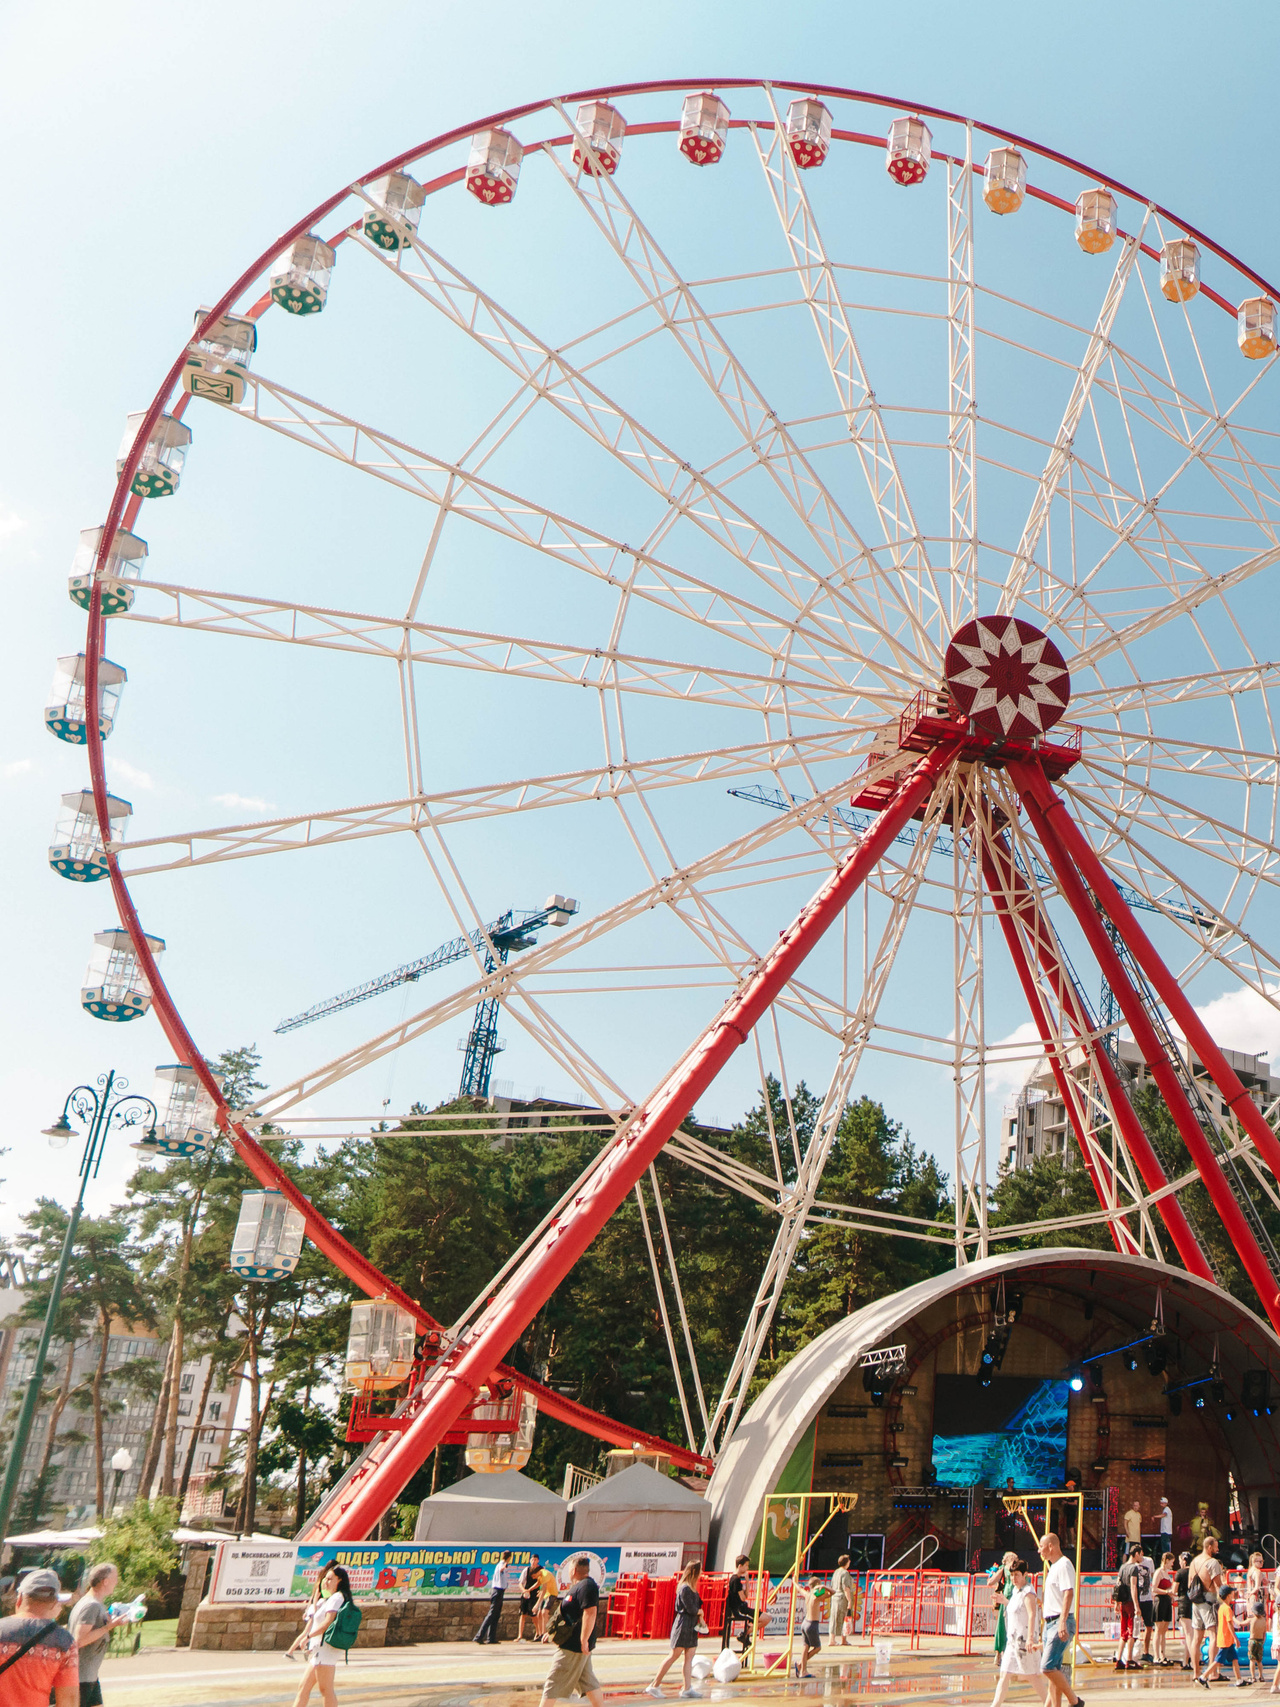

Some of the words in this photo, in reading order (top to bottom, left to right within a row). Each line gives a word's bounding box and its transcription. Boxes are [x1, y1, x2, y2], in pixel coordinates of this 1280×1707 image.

[335, 1551, 380, 1567] ЛІДЕР
[384, 1549, 478, 1565] УКРАЇНСЬКОЇ
[481, 1551, 531, 1565] ОСІТИ
[376, 1566, 489, 1590] ВЕРЕСЕНЬ
[226, 1587, 243, 1595] 050
[244, 1587, 285, 1595] 323-16-18
